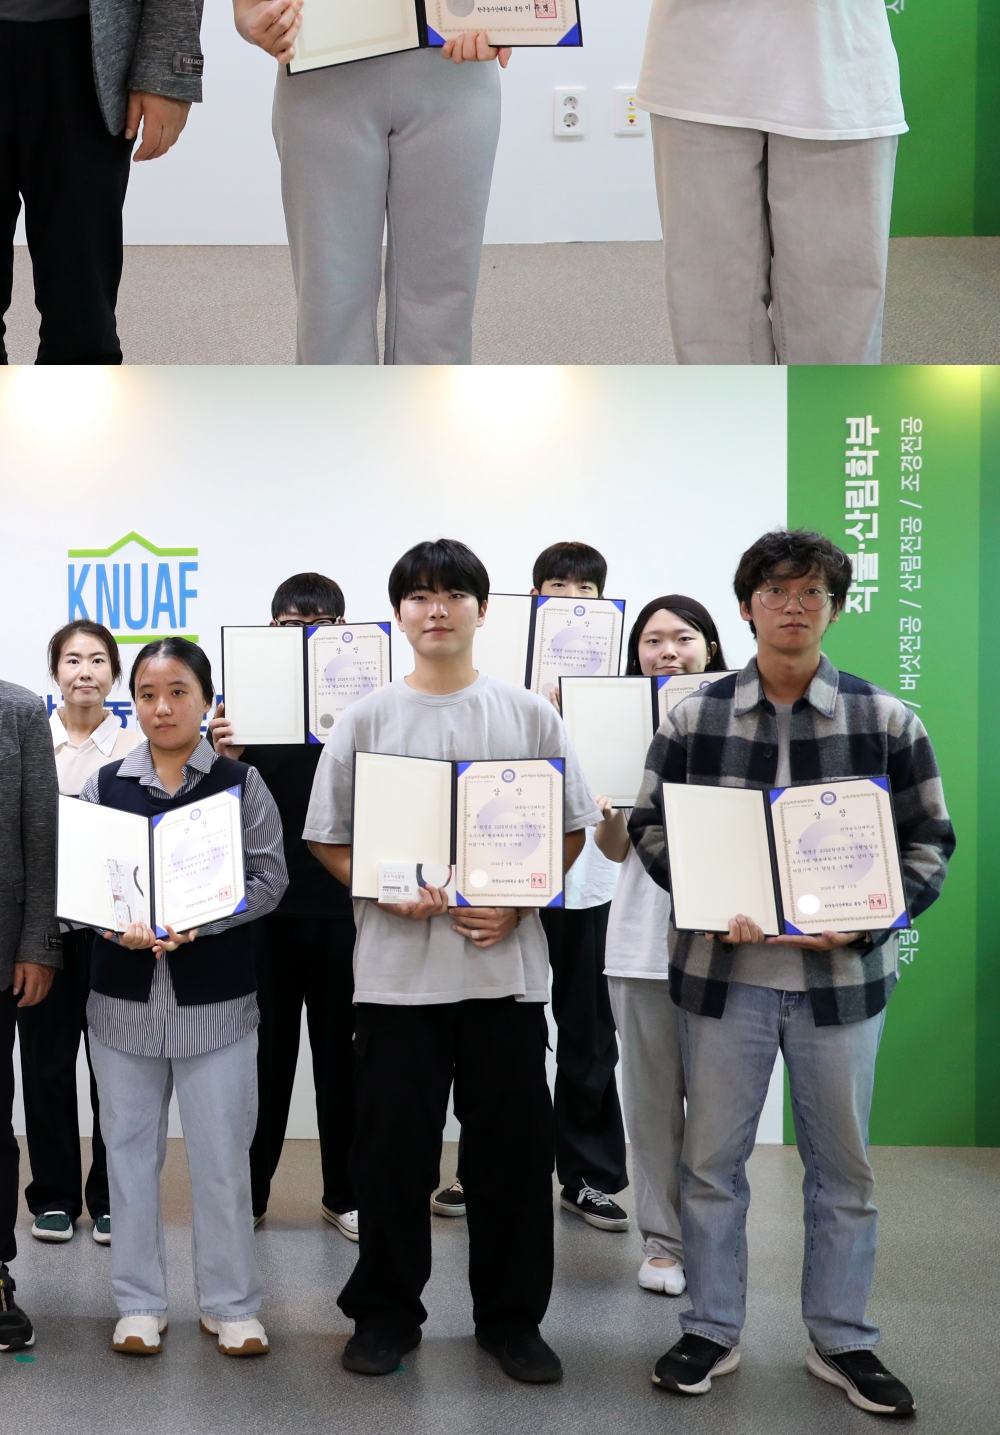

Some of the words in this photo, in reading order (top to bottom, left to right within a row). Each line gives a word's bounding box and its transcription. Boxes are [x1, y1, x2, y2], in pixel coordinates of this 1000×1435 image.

[901, 417, 923, 492] 조경전공
[846, 415, 880, 614] 작물·산림학부
[900, 516, 922, 591] 산림전공
[68, 562, 198, 630] KNUAF
[899, 616, 922, 690] 버섯전공
